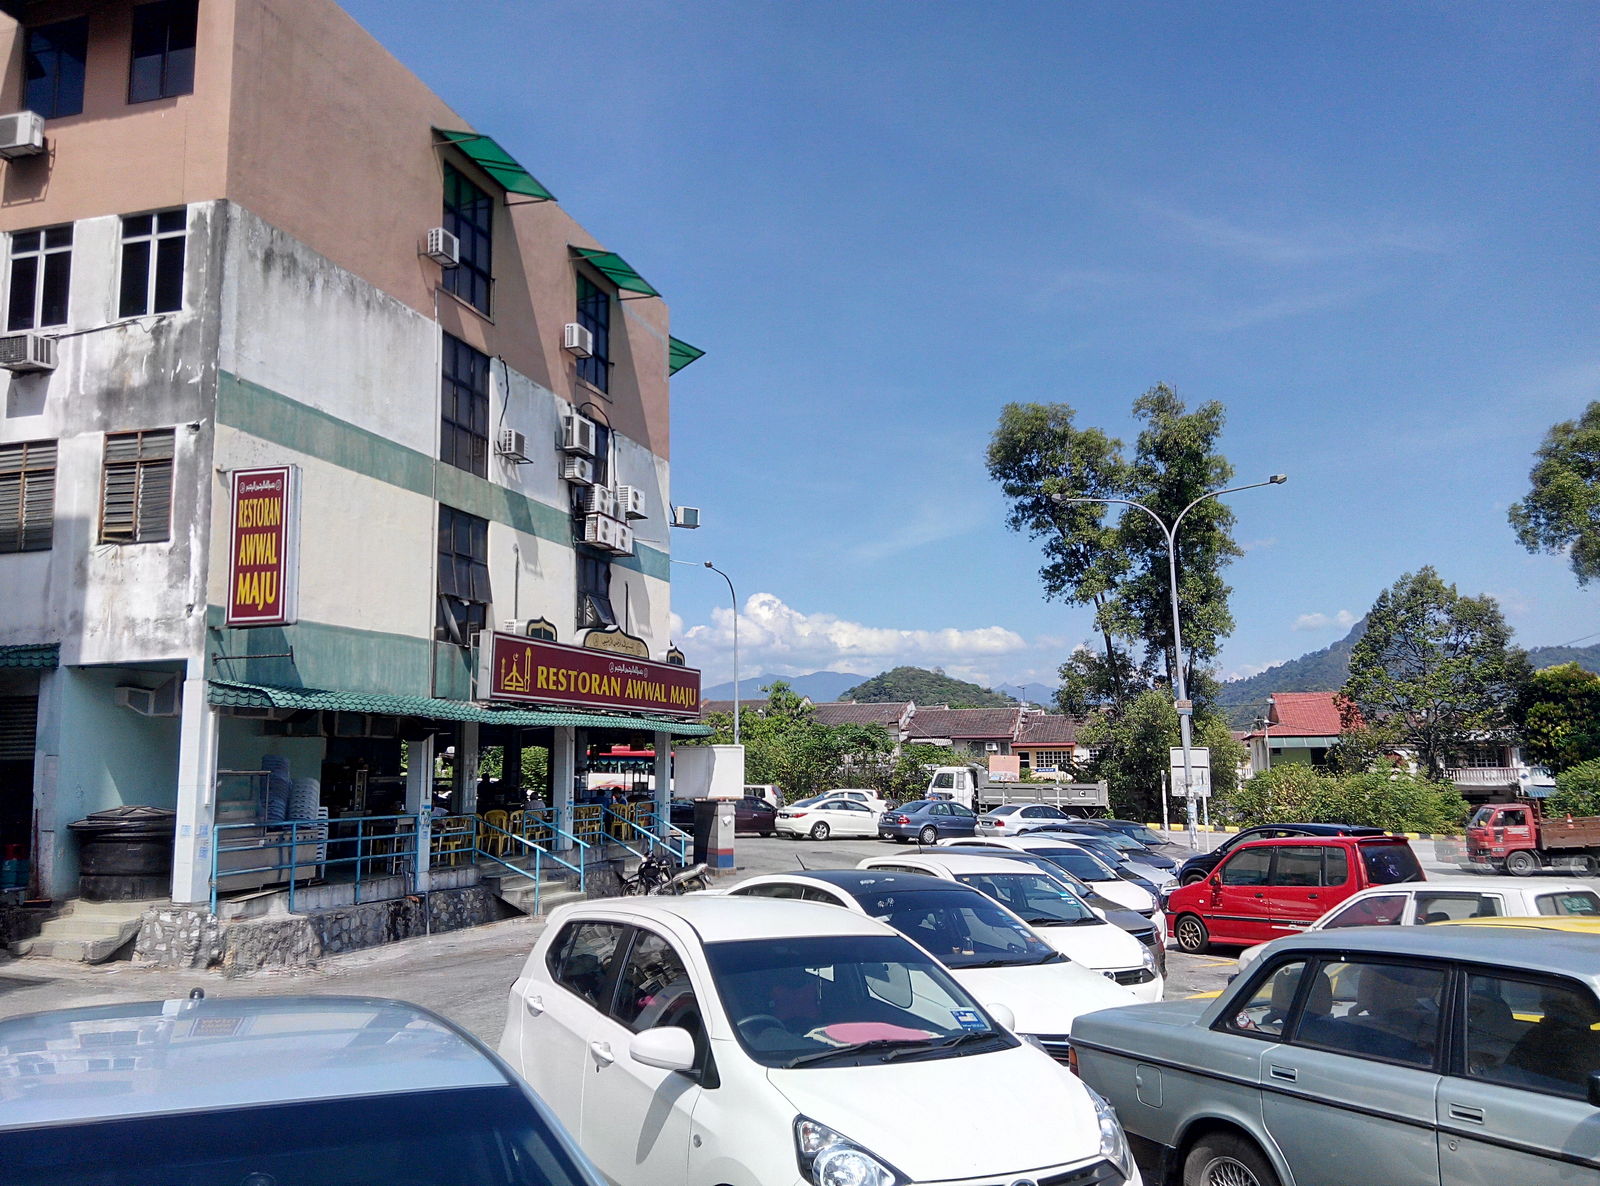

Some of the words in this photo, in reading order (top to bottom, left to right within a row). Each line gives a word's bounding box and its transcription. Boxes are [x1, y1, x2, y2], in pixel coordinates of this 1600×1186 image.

[238, 497, 281, 528] RESTORAN
[238, 533, 276, 566] AWWAL
[237, 572, 276, 610] MAJU
[538, 666, 620, 697] RESTORAN
[624, 678, 667, 703] AWWAL
[669, 685, 697, 708] MAJU
